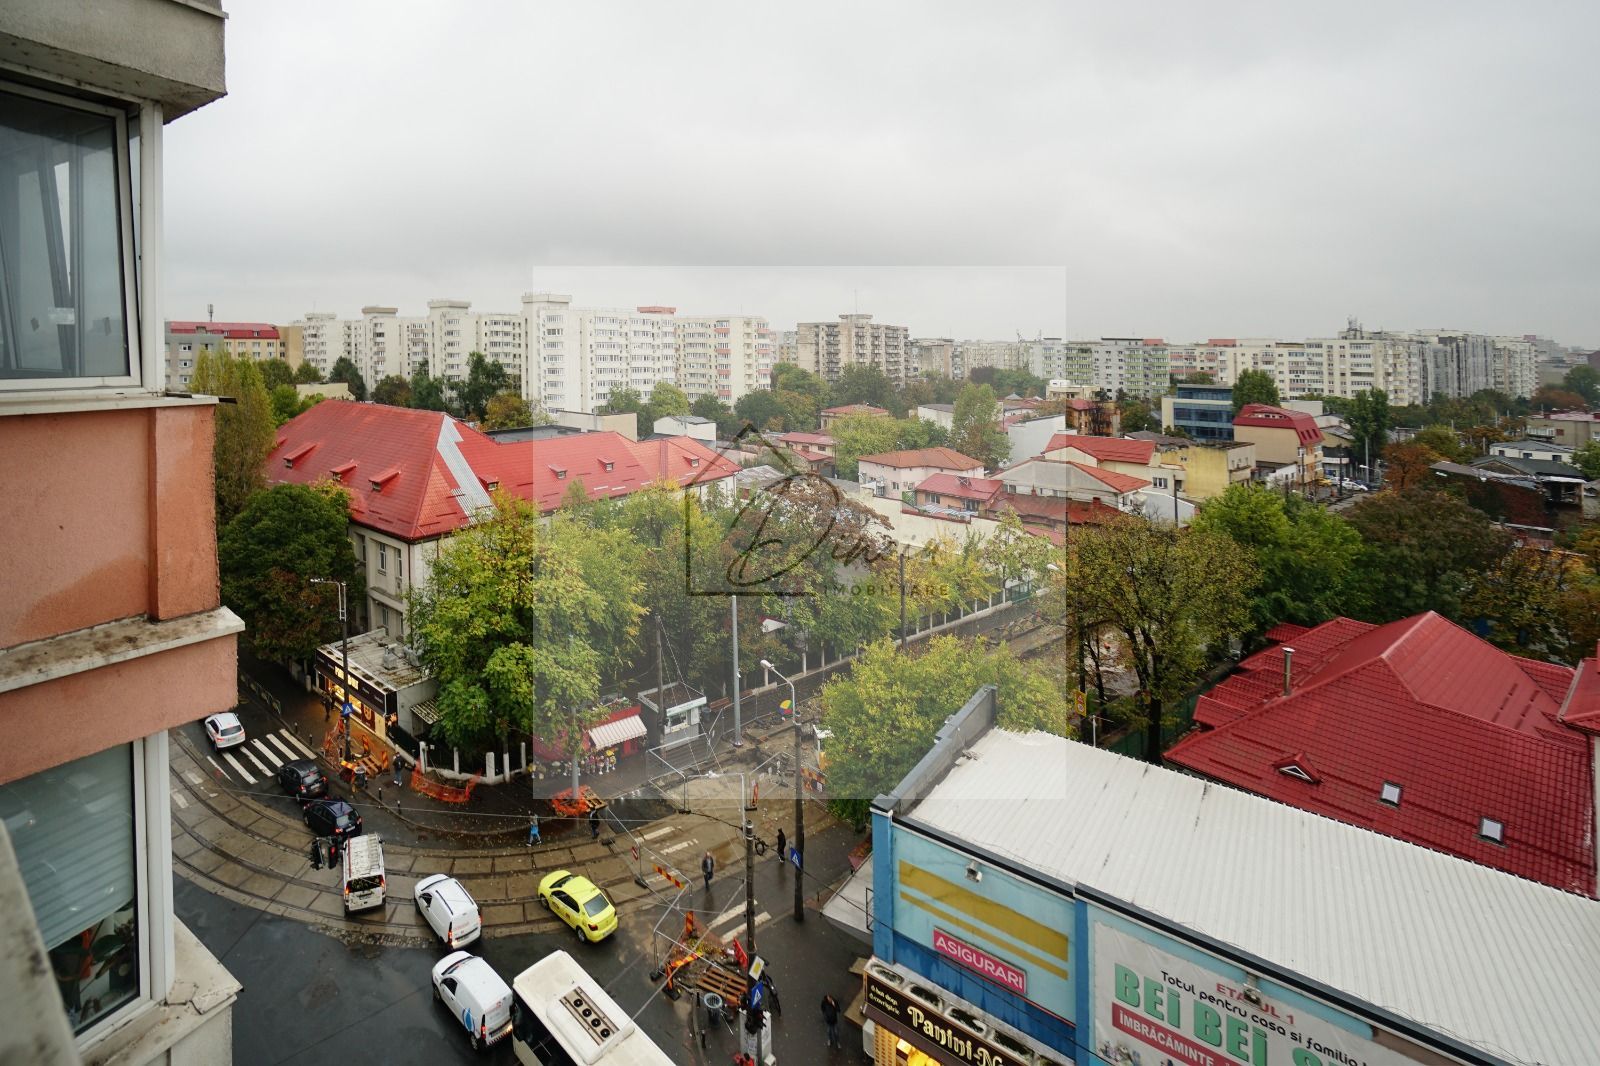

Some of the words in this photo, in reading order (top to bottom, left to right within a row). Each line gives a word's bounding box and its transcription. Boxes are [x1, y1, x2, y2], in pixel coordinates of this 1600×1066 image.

[935, 936, 1023, 990] ASIGURARI
[1161, 970, 1196, 995] Totul
[1199, 991, 1248, 1017] pentru
[1251, 1014, 1286, 1036] casa
[1290, 1031, 1302, 1044] si
